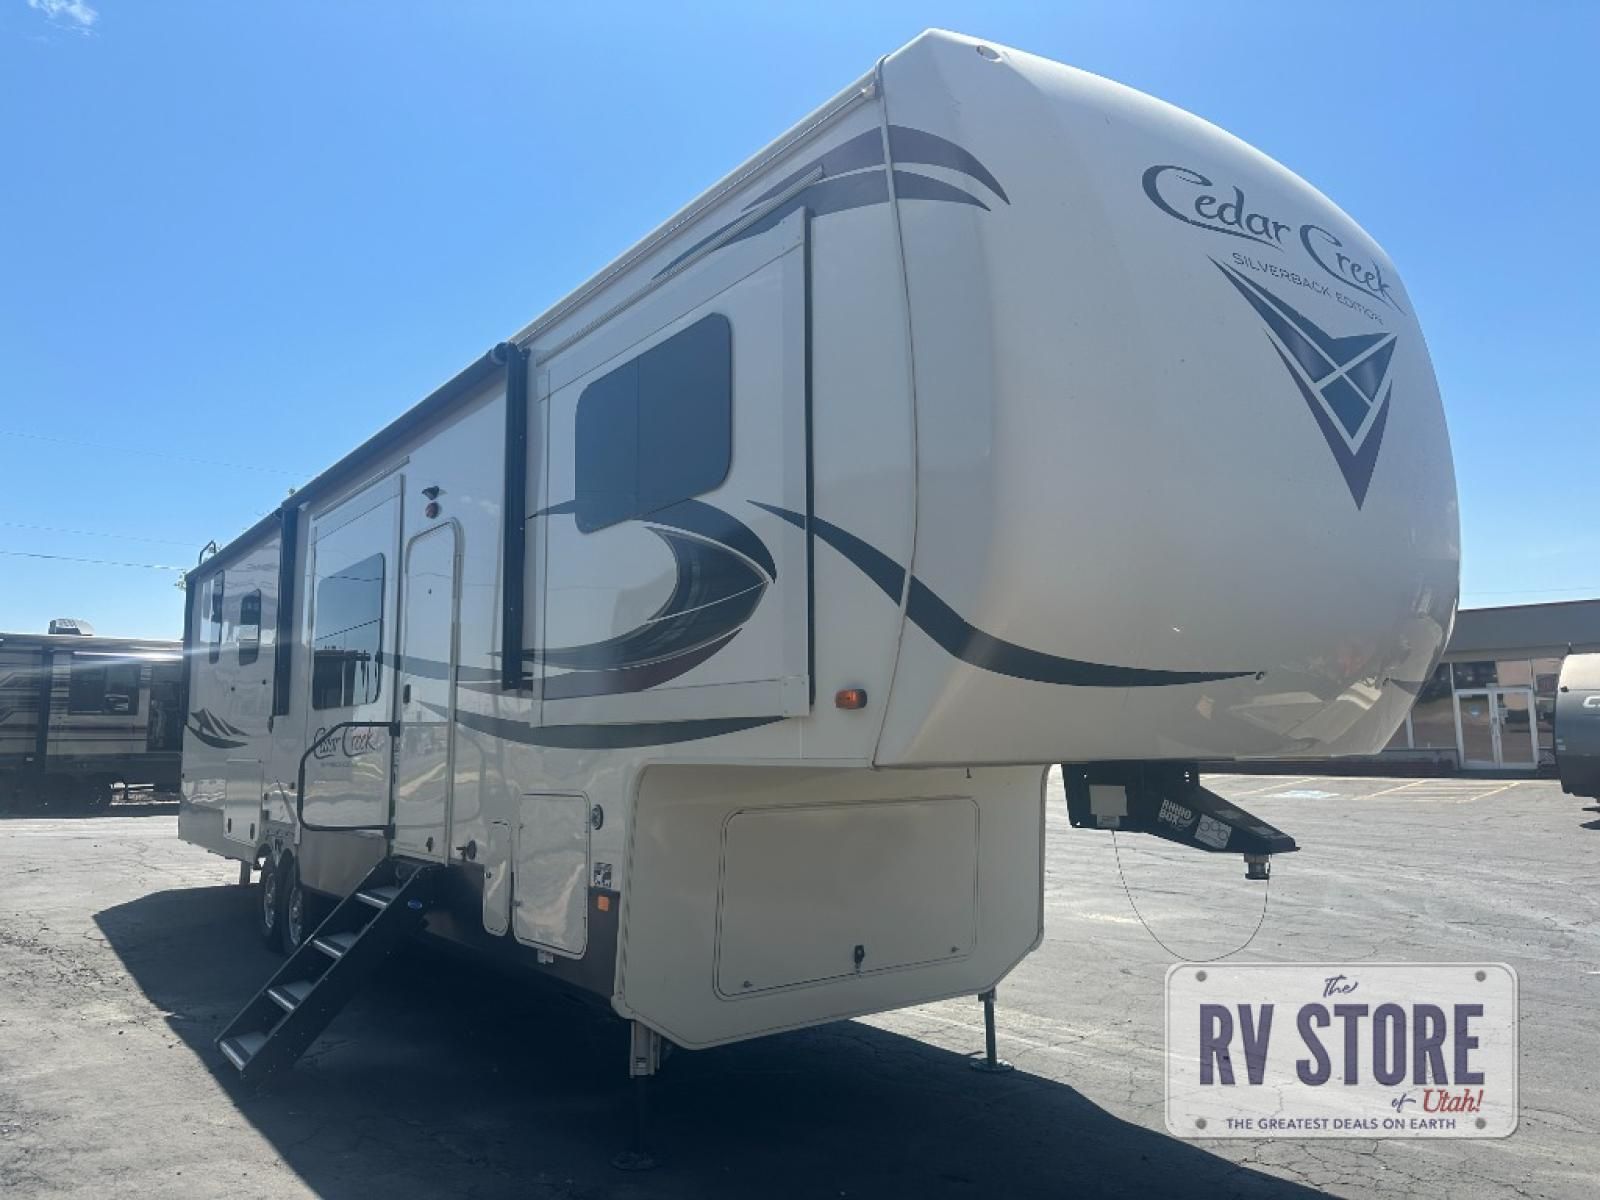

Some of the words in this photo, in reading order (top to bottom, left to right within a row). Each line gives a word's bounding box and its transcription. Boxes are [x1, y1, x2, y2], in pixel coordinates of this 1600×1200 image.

[1142, 165, 1290, 251] Cedar
[1300, 224, 1405, 315] Creek
[1232, 252, 1331, 298] SILVERBACK
[1159, 808, 1179, 825] BOX
[1162, 799, 1192, 820] RHINO
